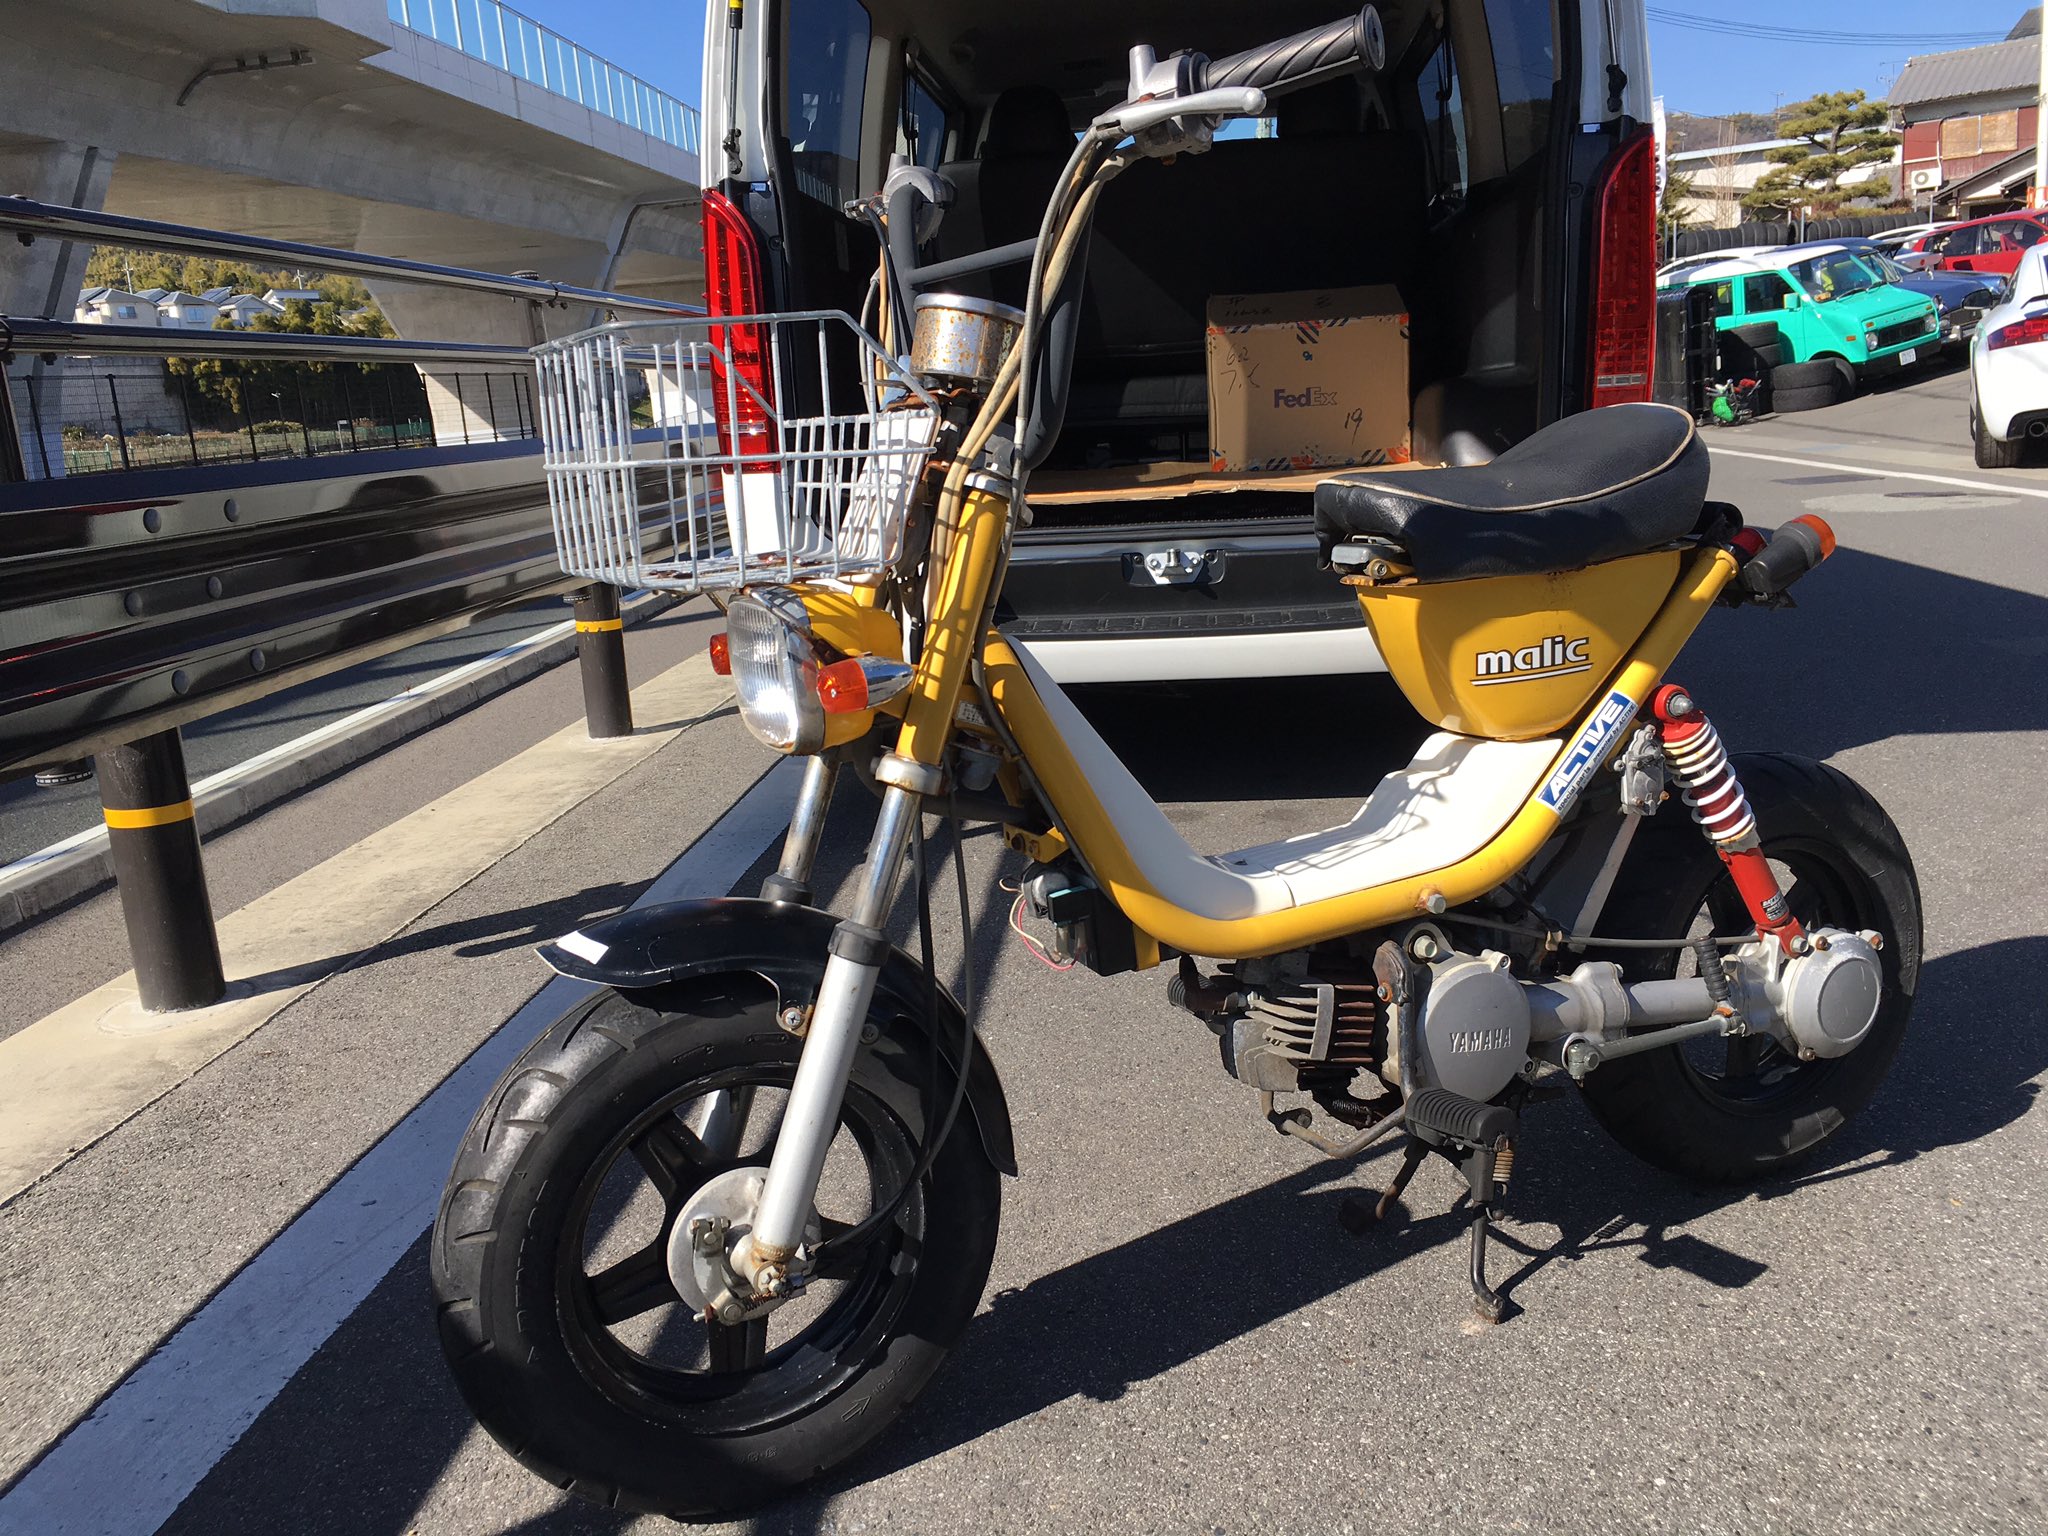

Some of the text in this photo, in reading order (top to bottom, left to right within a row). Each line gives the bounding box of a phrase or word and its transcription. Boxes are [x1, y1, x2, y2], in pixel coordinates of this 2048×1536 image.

[1273, 386, 1338, 408] FedEx
[1344, 407, 1362, 445] 19
[1475, 634, 1590, 677] malic
[1549, 699, 1624, 802] ACTIVE
[1557, 704, 1635, 811] special parts presented by ACTIVE
[1449, 1027, 1512, 1054] YAMAHA
